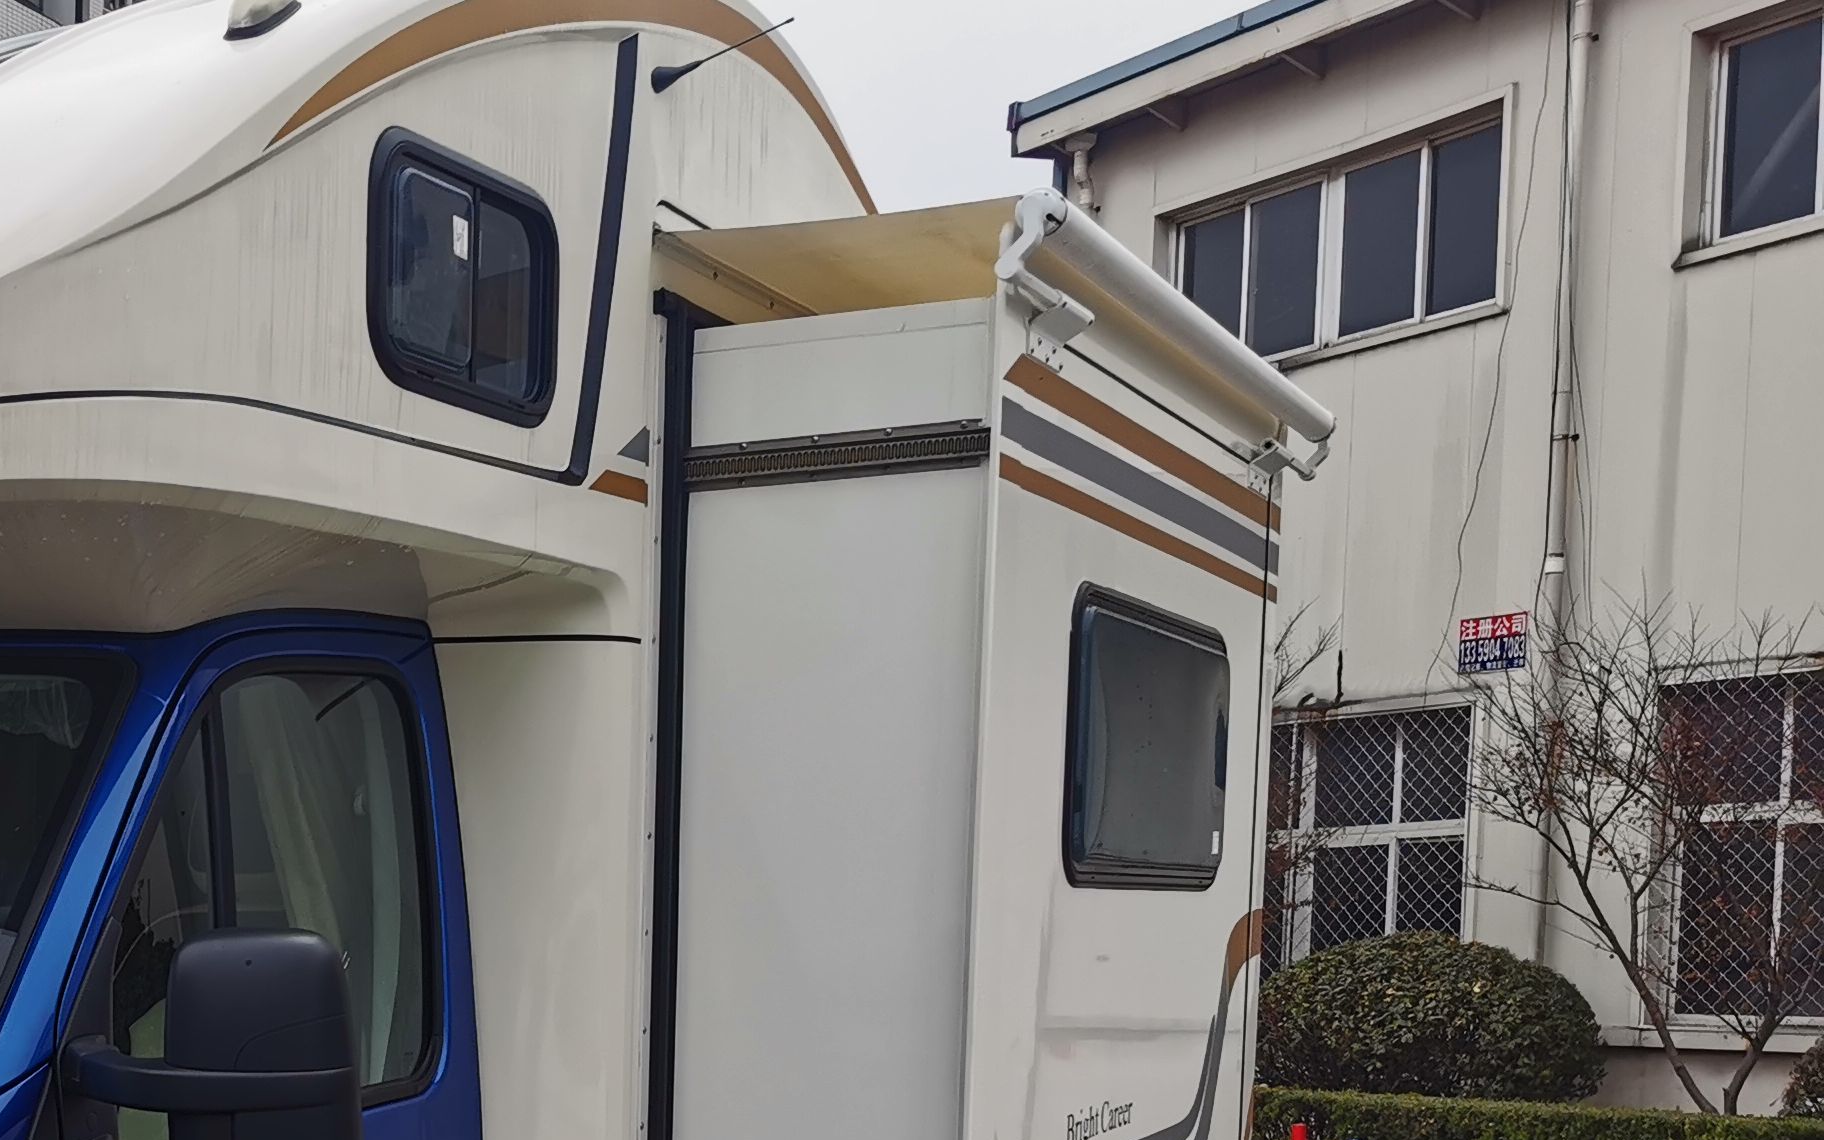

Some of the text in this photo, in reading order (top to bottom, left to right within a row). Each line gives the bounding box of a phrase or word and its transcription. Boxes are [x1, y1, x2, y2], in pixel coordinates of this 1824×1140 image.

[1460, 614, 1527, 641] 注册公司
[1460, 641, 1476, 664] 133
[1100, 1101, 1133, 1133] Career
